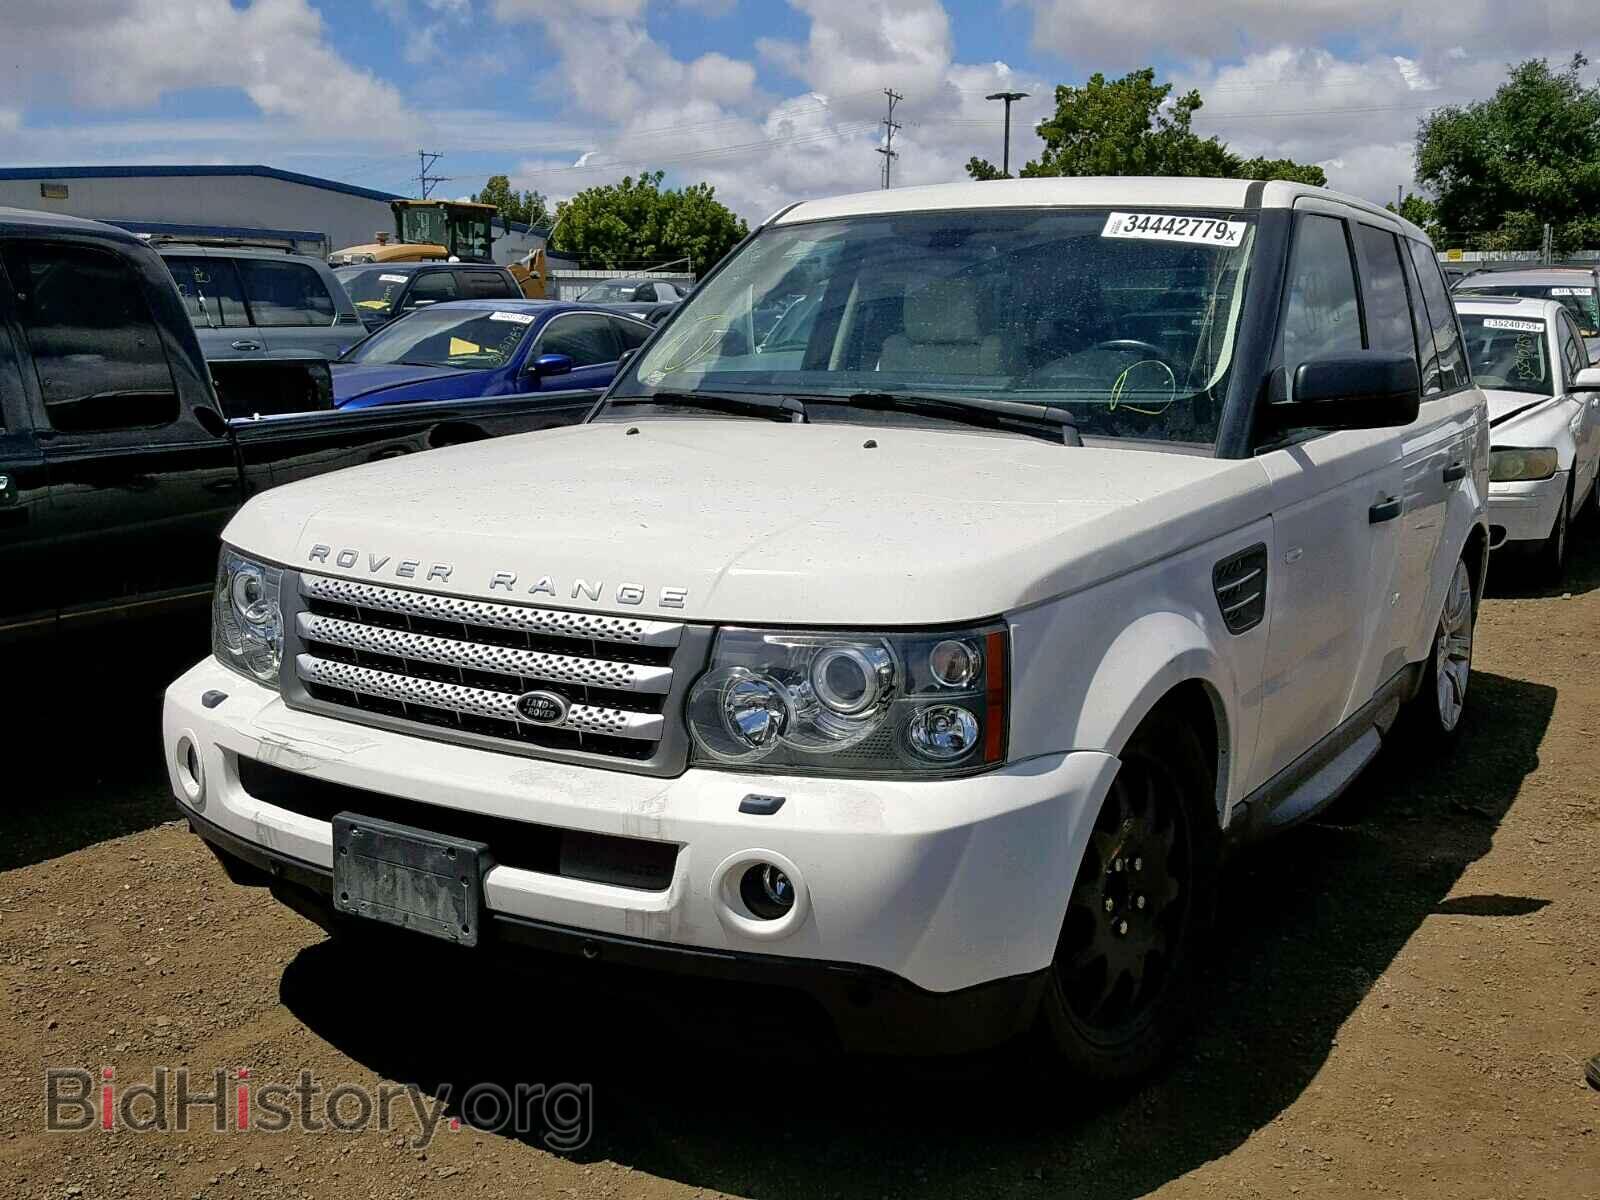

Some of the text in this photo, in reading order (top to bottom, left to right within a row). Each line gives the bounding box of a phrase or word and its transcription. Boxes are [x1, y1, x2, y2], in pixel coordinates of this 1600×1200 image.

[308, 543, 689, 608] ROVER RANGE
[526, 698, 549, 709] LAND
[528, 707, 556, 718] ROVER
